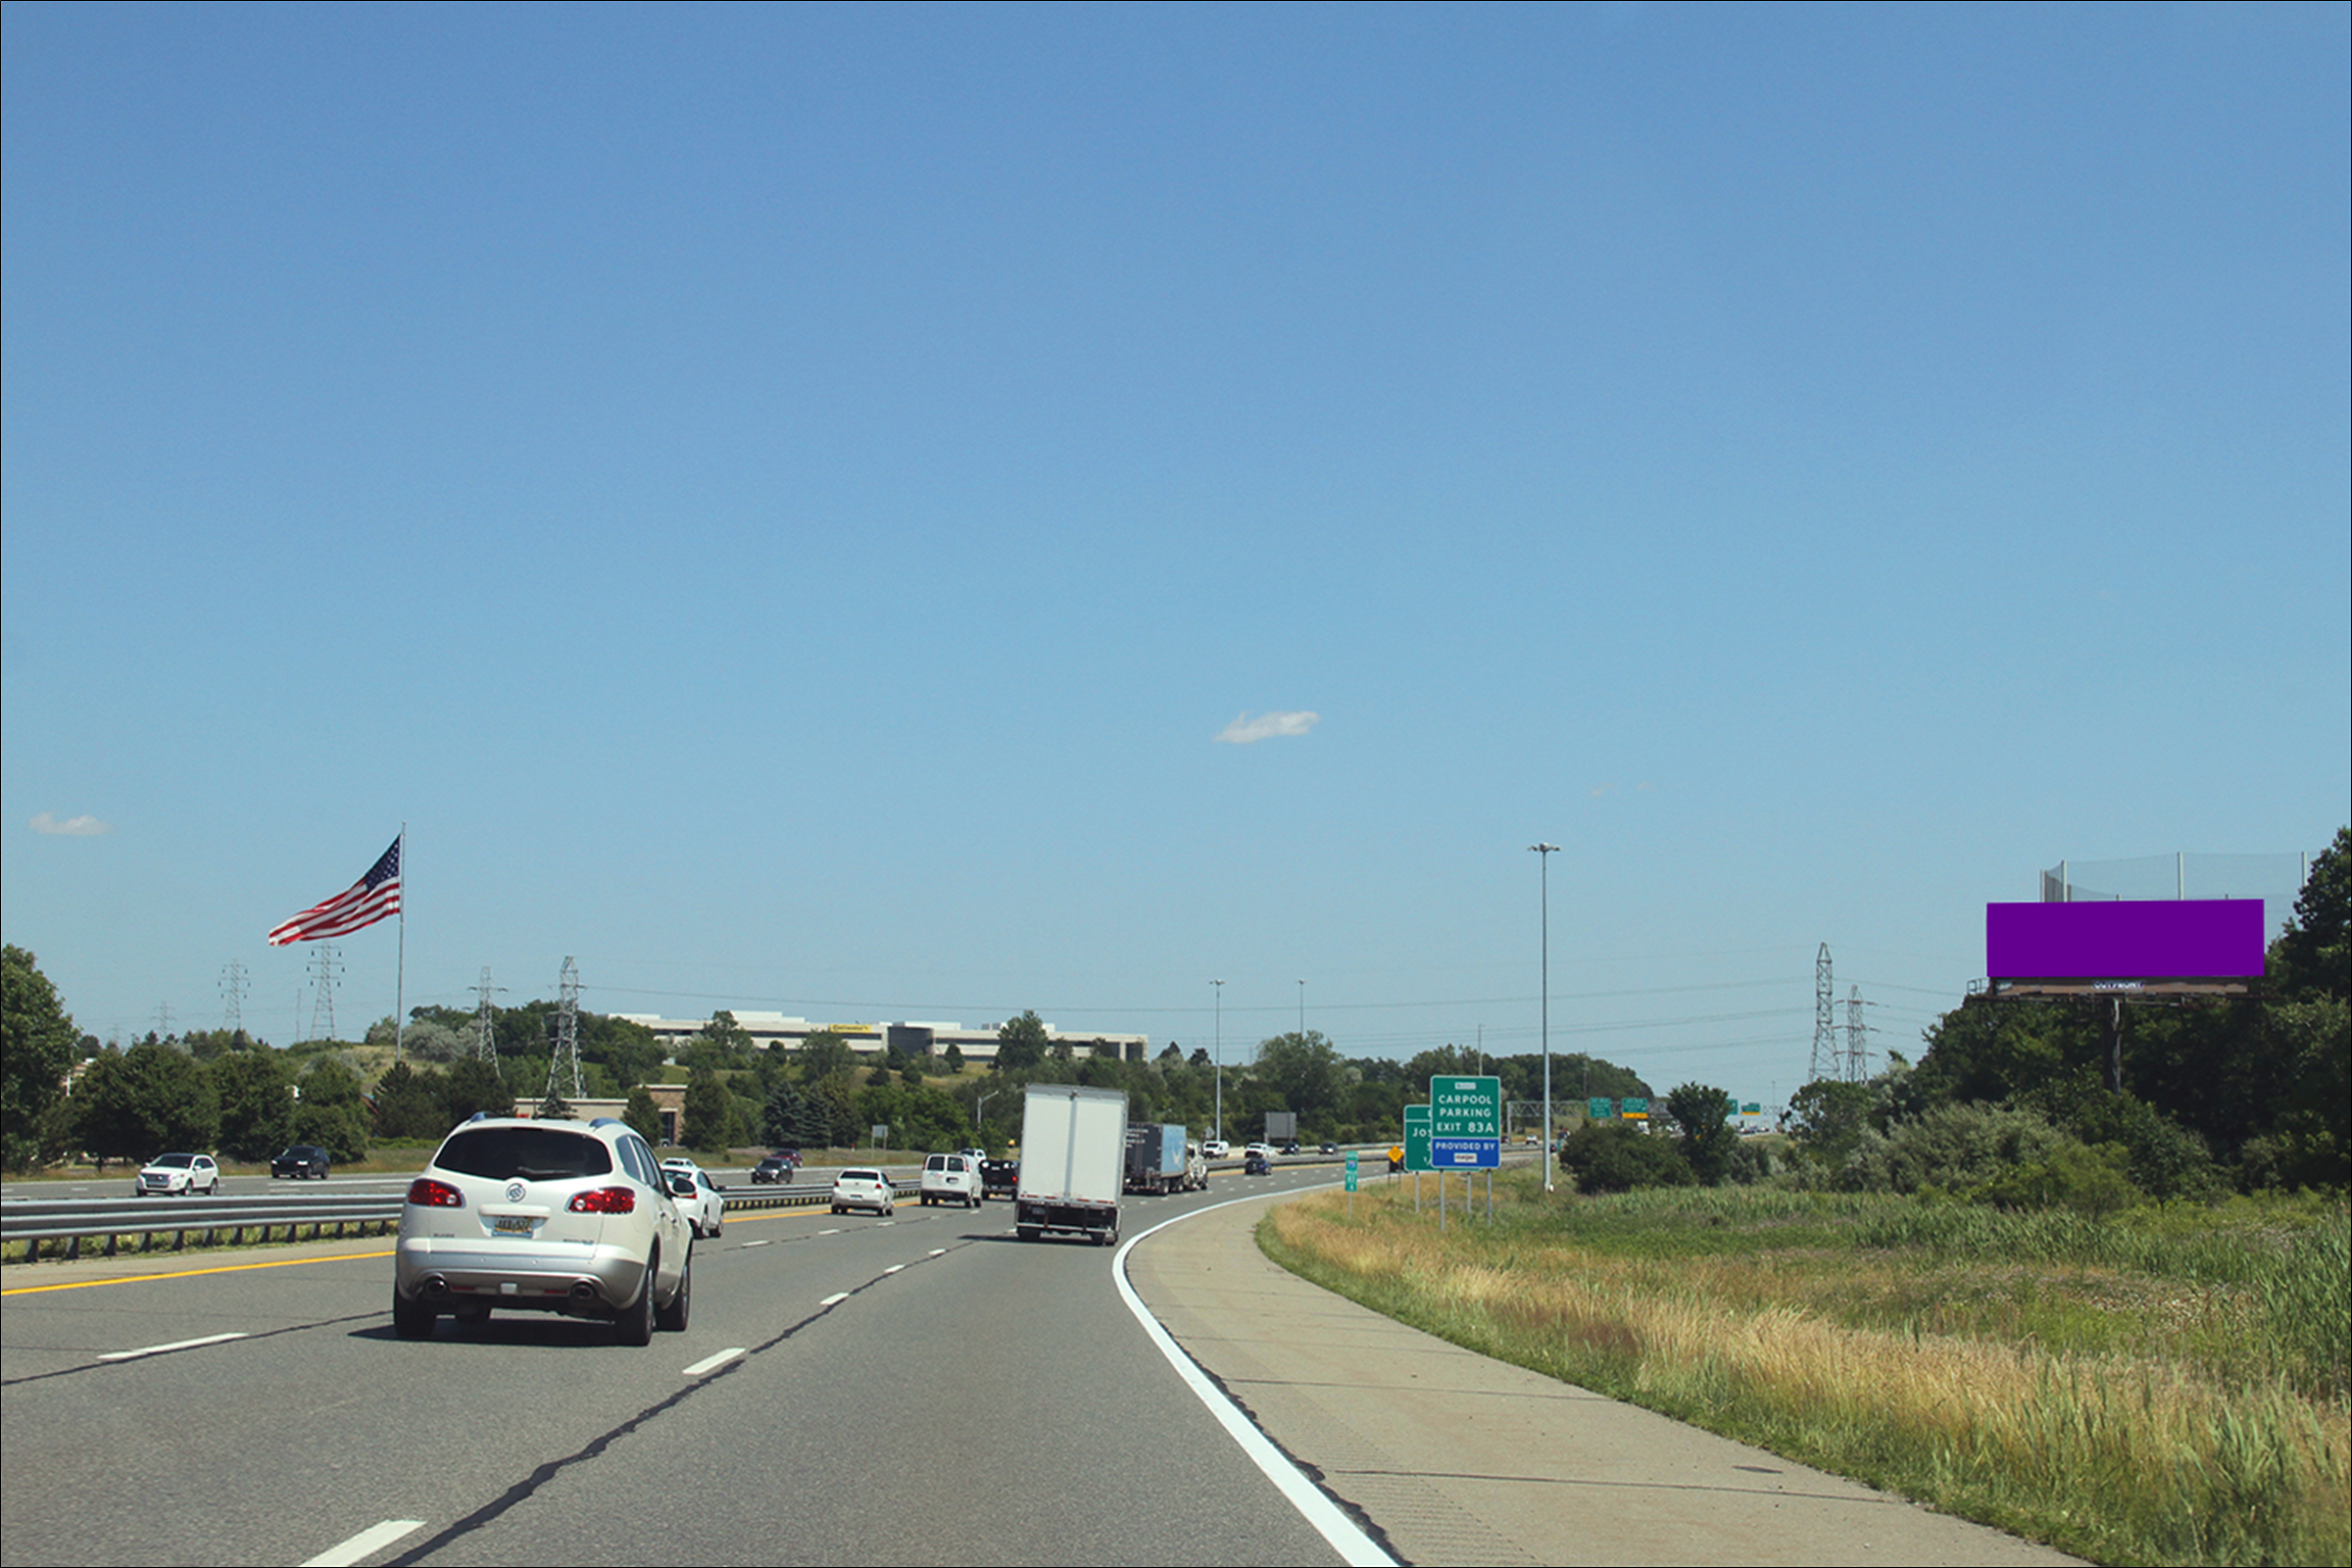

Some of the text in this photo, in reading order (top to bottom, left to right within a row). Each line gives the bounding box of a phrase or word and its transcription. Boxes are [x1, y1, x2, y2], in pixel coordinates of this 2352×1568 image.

[1438, 1095, 1493, 1104] CARPOOL
[1440, 1107, 1492, 1117] PARKING
[1437, 1121, 1494, 1133] EXIT 83A
[1436, 1142, 1481, 1151] PROVIDED
[1484, 1142, 1495, 1151] BY
